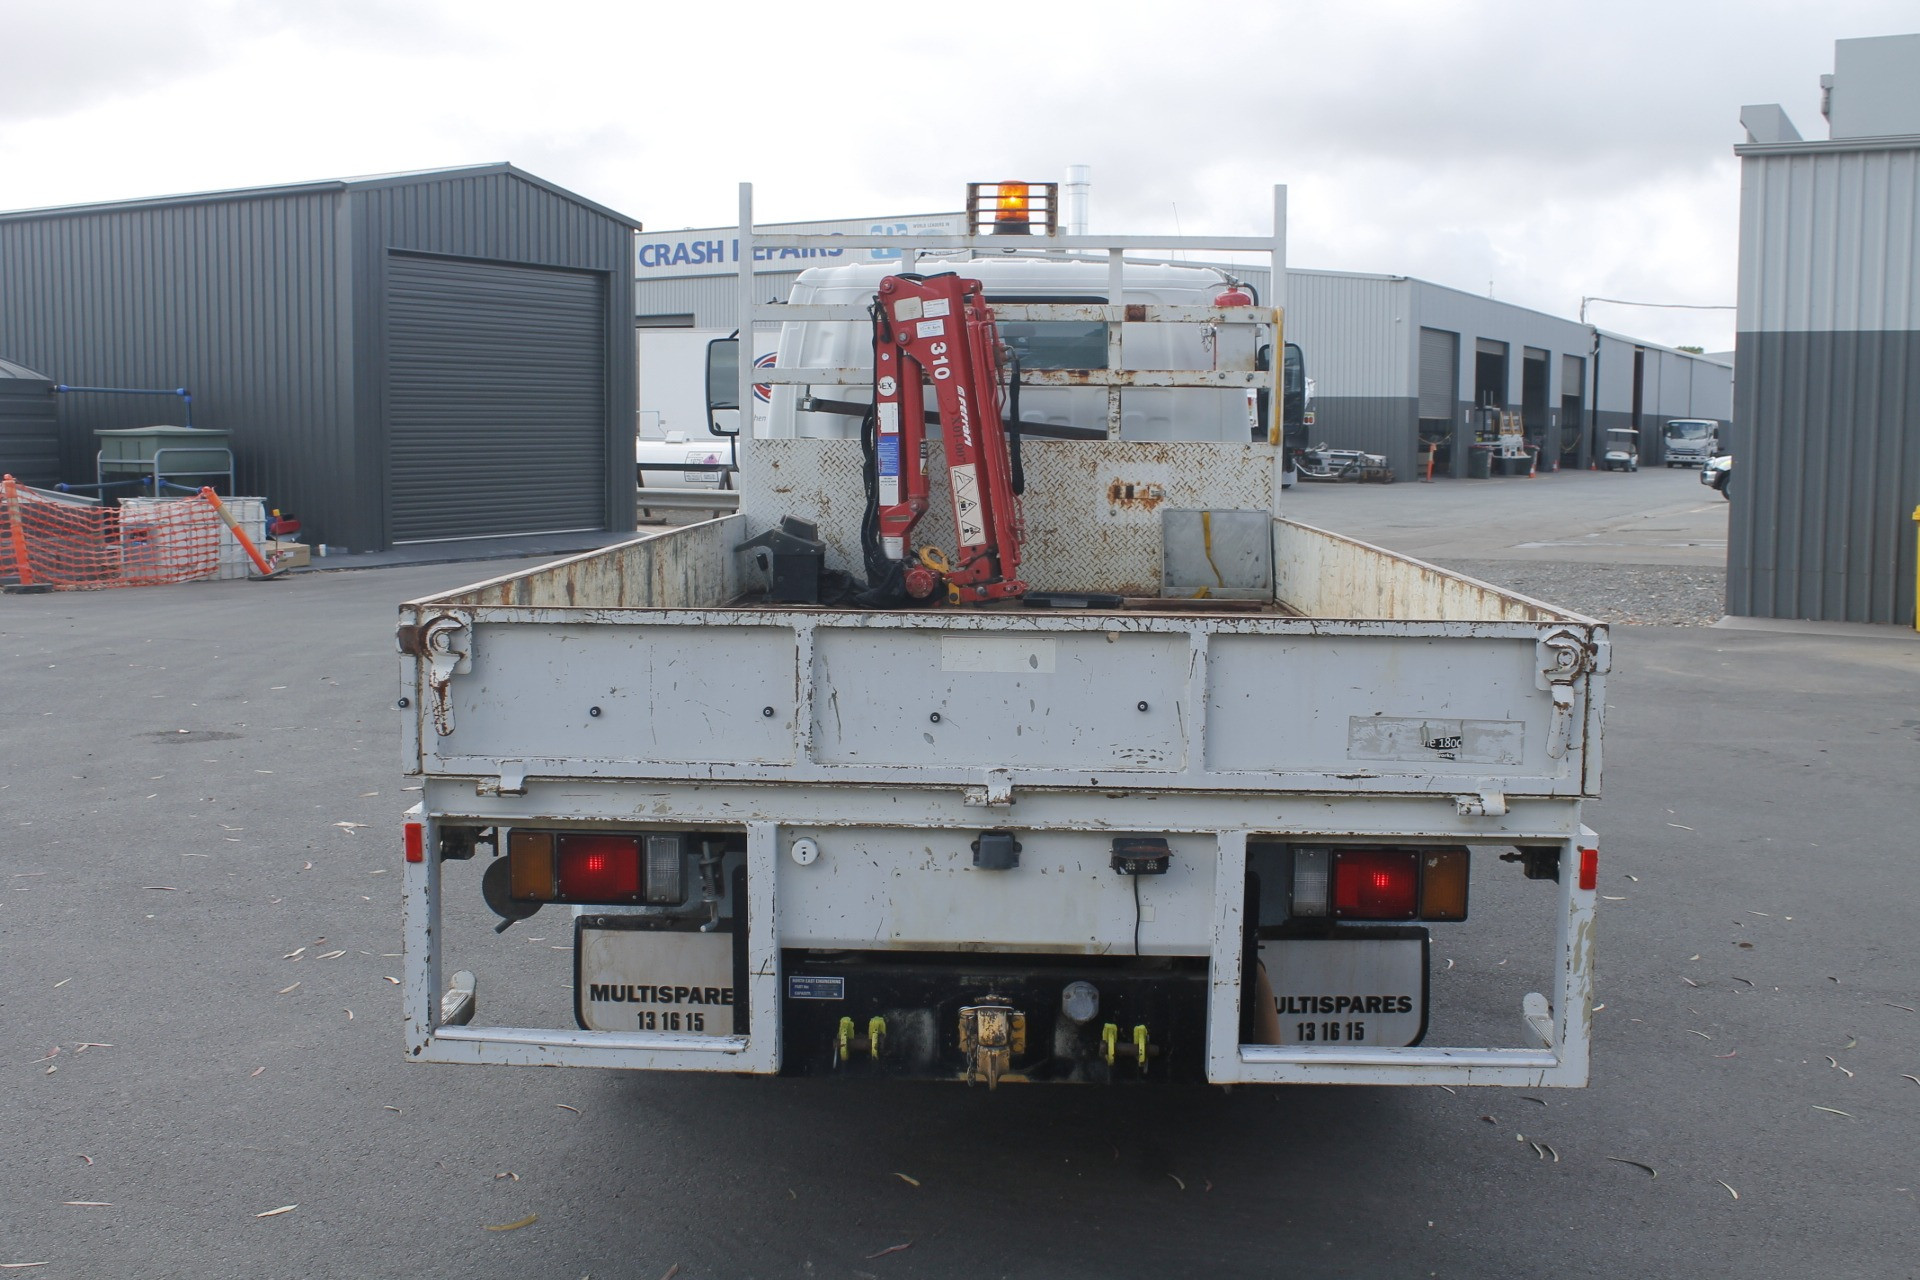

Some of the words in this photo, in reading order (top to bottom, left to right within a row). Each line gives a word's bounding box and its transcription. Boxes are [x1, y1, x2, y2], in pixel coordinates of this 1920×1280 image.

[639, 240, 724, 268] CRASH
[733, 233, 844, 262] EPAIRS
[930, 341, 951, 380] 310
[637, 1011, 656, 1031] 13
[661, 1011, 681, 1031] 16
[685, 1012, 704, 1032] 15
[1297, 1022, 1316, 1041] 13
[1321, 1022, 1340, 1041] 16
[1345, 1021, 1365, 1041] 15
